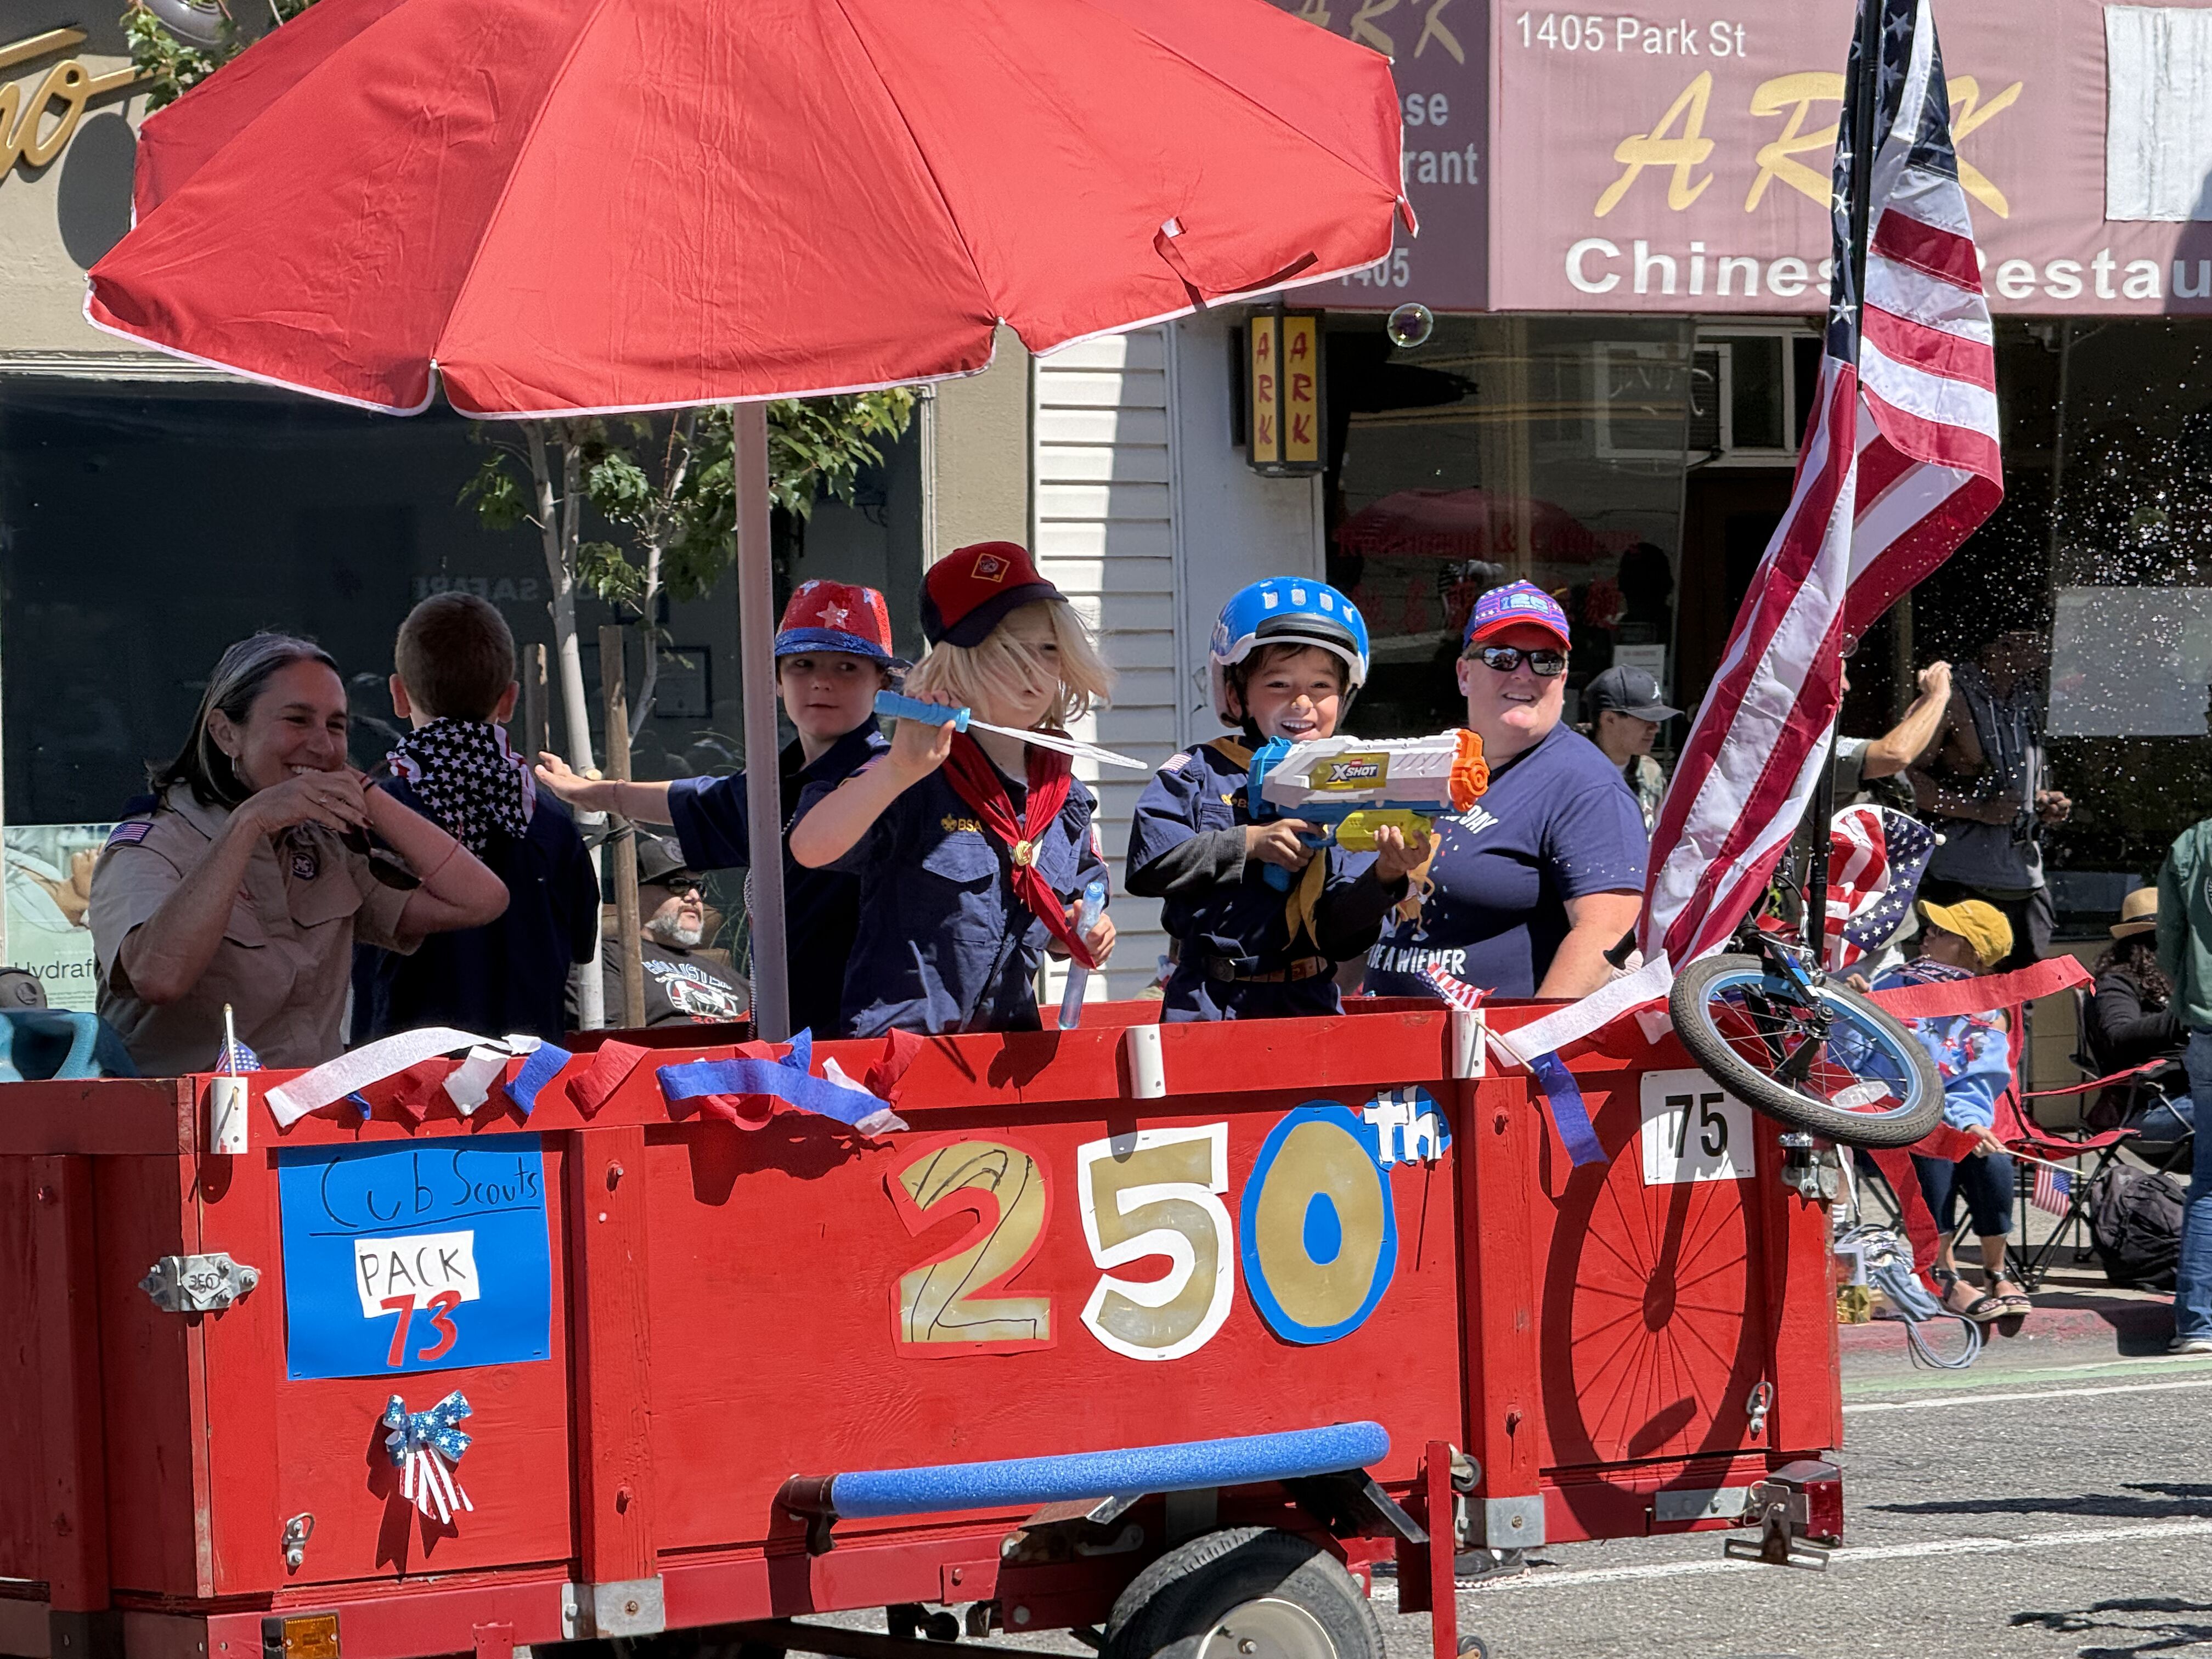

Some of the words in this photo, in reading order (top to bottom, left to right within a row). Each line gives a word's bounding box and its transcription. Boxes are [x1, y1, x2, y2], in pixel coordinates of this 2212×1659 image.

[1295, 0, 1465, 65] RK
[1516, 11, 1605, 52] 1405
[1616, 17, 1699, 55] Park
[1708, 20, 1746, 57] St
[1399, 93, 1449, 127] se
[1976, 247, 2211, 300] estau
[1256, 331, 1273, 445] ARK
[1289, 331, 1312, 445] ARK
[1330, 764, 1377, 781] XSHOT
[958, 818, 983, 833] BSA
[1458, 804, 1499, 834] DAY
[1396, 946, 1466, 975] WIENER
[1664, 1092, 1729, 1160] 75
[321, 1152, 434, 1228] Cub
[451, 1149, 538, 1206] Scouts
[359, 1246, 467, 1297] PACK
[380, 1289, 462, 1368] 73
